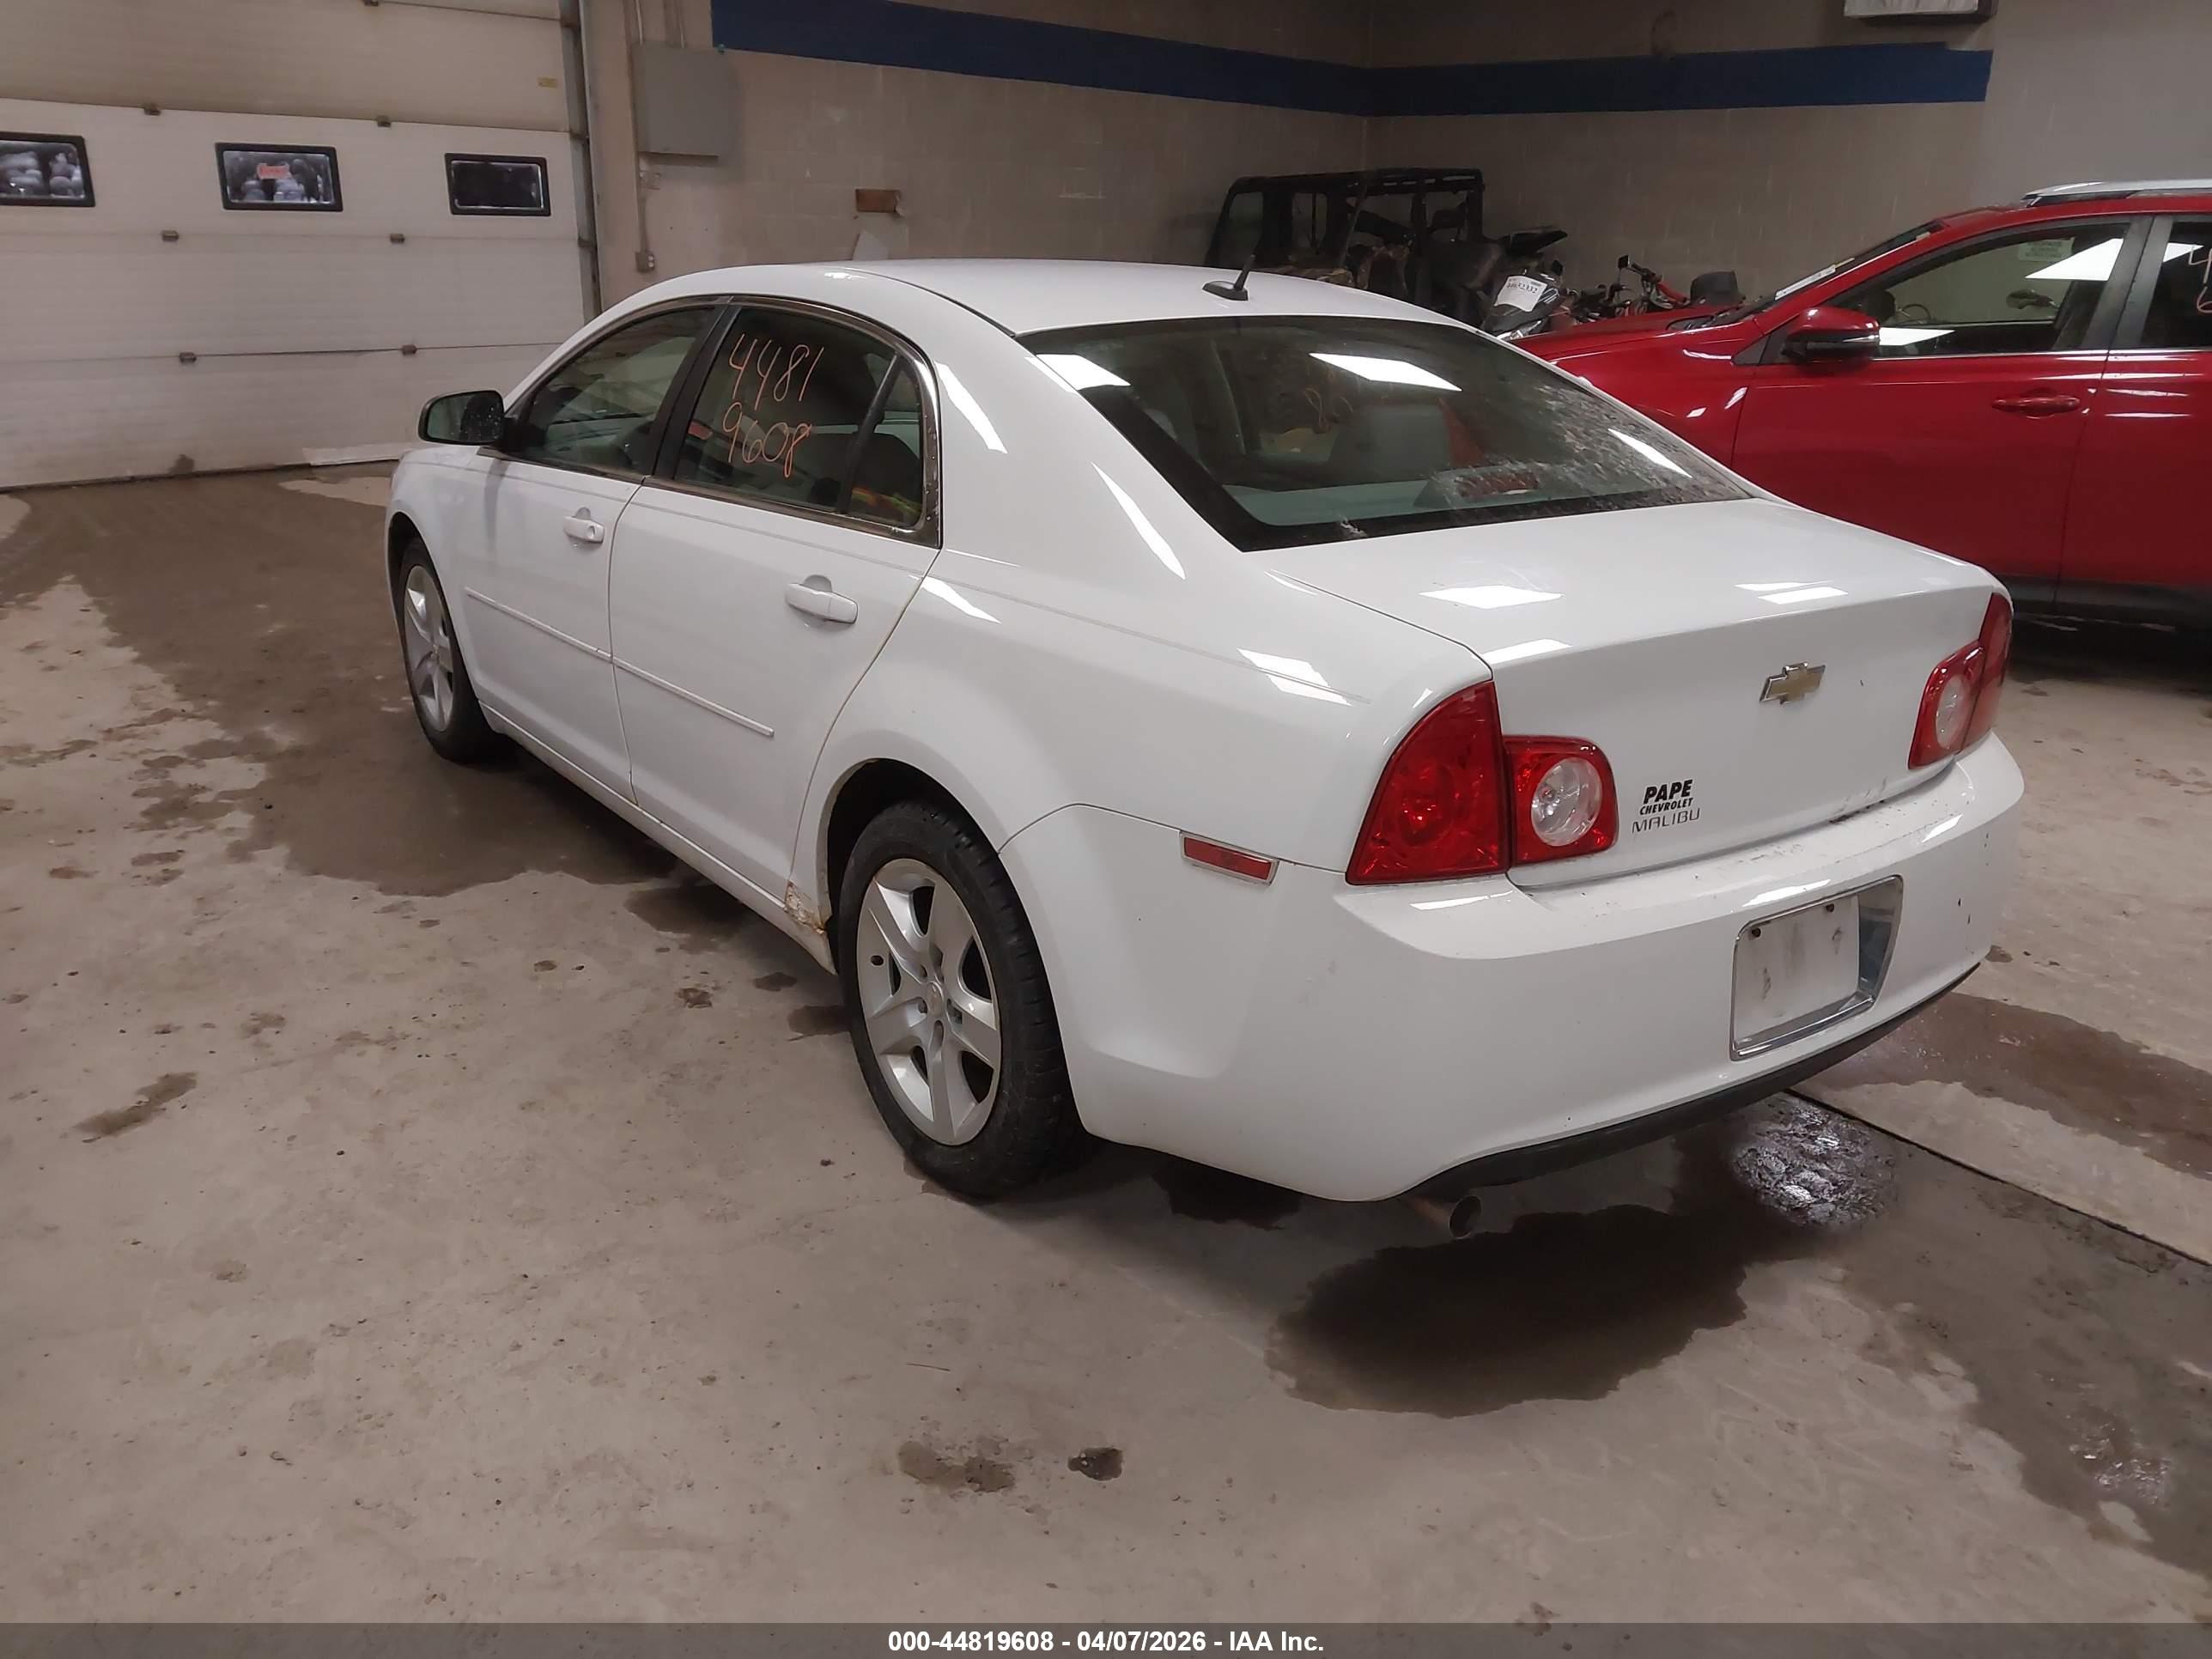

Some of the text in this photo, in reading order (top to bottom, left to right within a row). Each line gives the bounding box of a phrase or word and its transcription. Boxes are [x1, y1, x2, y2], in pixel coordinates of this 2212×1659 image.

[729, 333, 824, 411] 4481
[722, 401, 812, 477] 9608
[1643, 779, 1693, 805] PAPE
[1639, 797, 1693, 816] CHEVROLET
[1632, 807, 1700, 834] MALIBU
